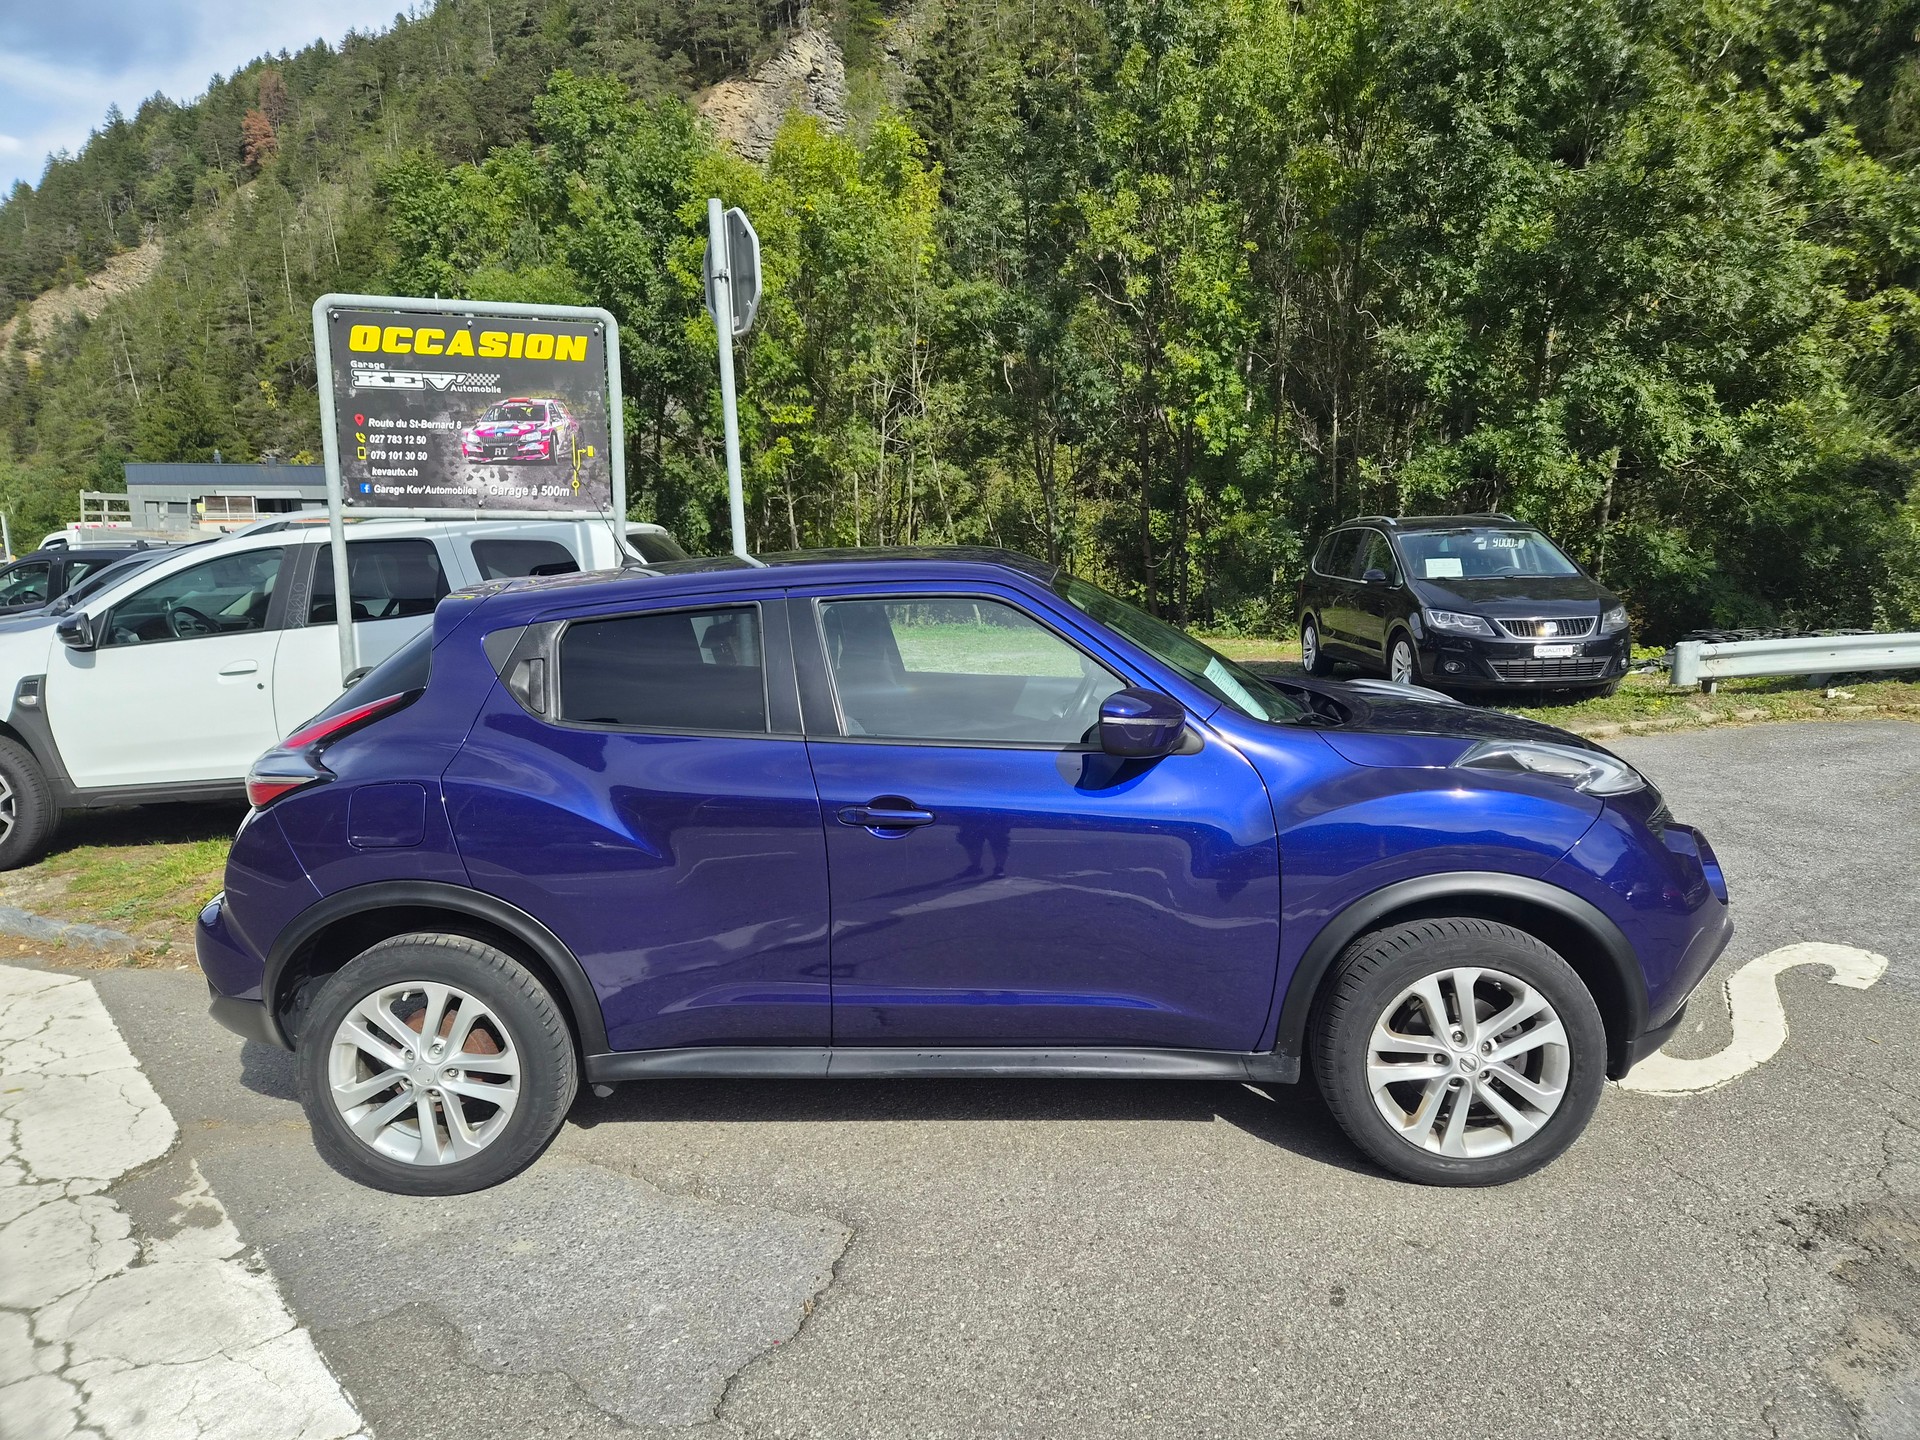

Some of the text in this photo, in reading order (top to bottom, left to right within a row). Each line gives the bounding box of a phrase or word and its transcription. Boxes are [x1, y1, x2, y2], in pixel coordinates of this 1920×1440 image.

[349, 325, 588, 361] OCCASION
[350, 360, 385, 370] Garage
[450, 385, 501, 393] Automobile
[368, 418, 463, 429] Route du St-Bernard 8
[369, 434, 427, 444] 027 783 12 50
[370, 450, 427, 460] 079 101 30 50
[372, 467, 418, 476] kevauto.ch
[374, 485, 477, 496] Garage Kev'Automobiles
[489, 485, 570, 498] Garage à 500m
